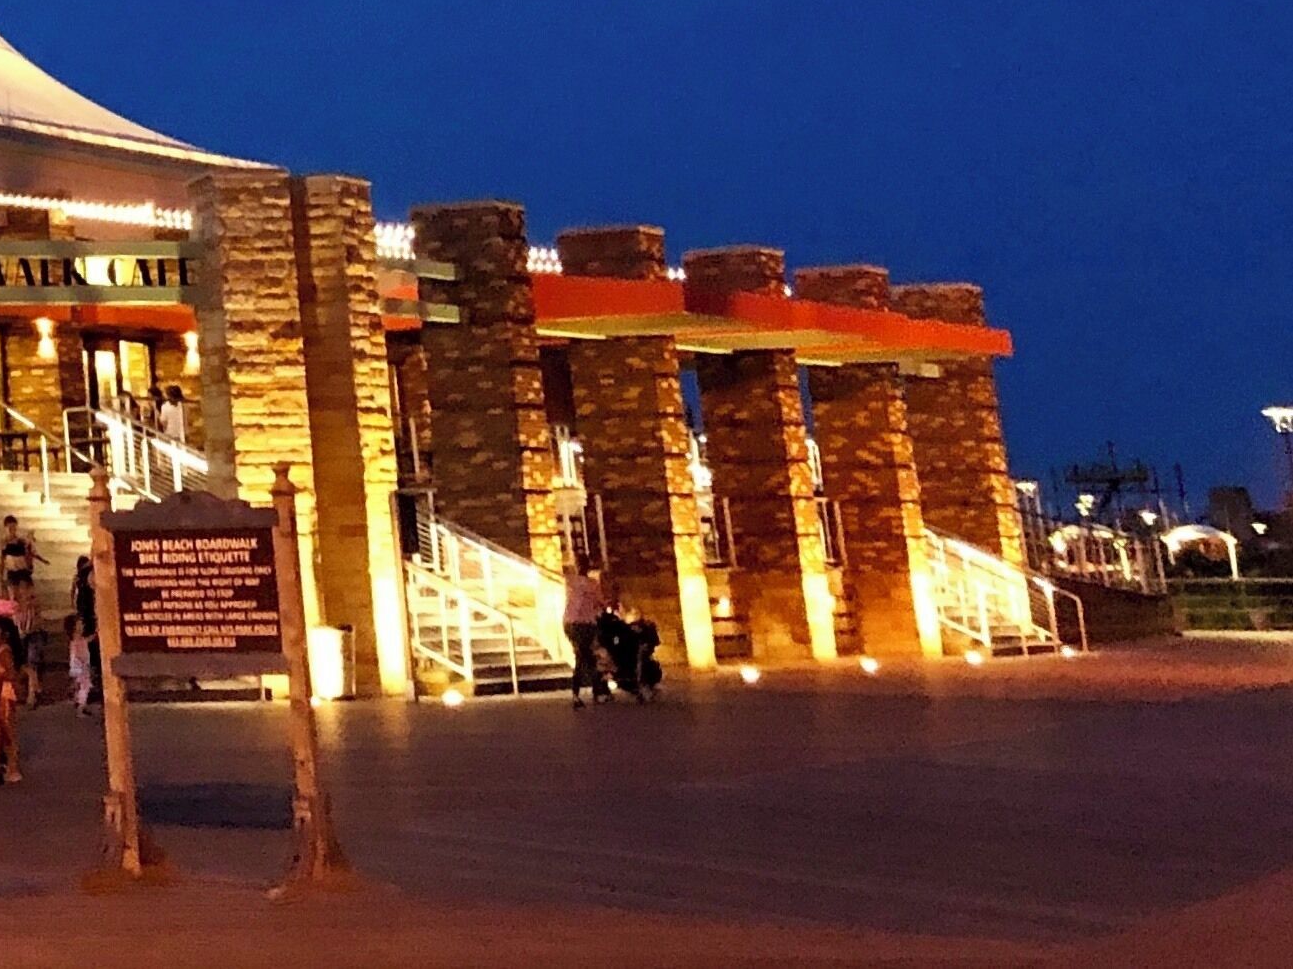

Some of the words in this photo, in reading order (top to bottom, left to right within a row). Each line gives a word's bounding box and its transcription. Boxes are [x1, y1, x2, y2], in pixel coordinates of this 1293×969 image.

[131, 539, 159, 551] JONES
[163, 539, 193, 551] BEACH
[195, 538, 257, 550] BOARDWALK
[139, 553, 160, 564] BIKE
[163, 552, 196, 563] RIDING
[198, 551, 250, 563] ETIQUETTE
[186, 567, 198, 575] FOR
[200, 567, 219, 575] SLOW
[254, 566, 271, 575] ONLY
[212, 578, 232, 586] RIGHT
[234, 578, 242, 586] OF
[206, 589, 215, 597] TO
[217, 589, 234, 597] STOP
[220, 600, 257, 608] APPROACH
[225, 612, 245, 620] LARGE
